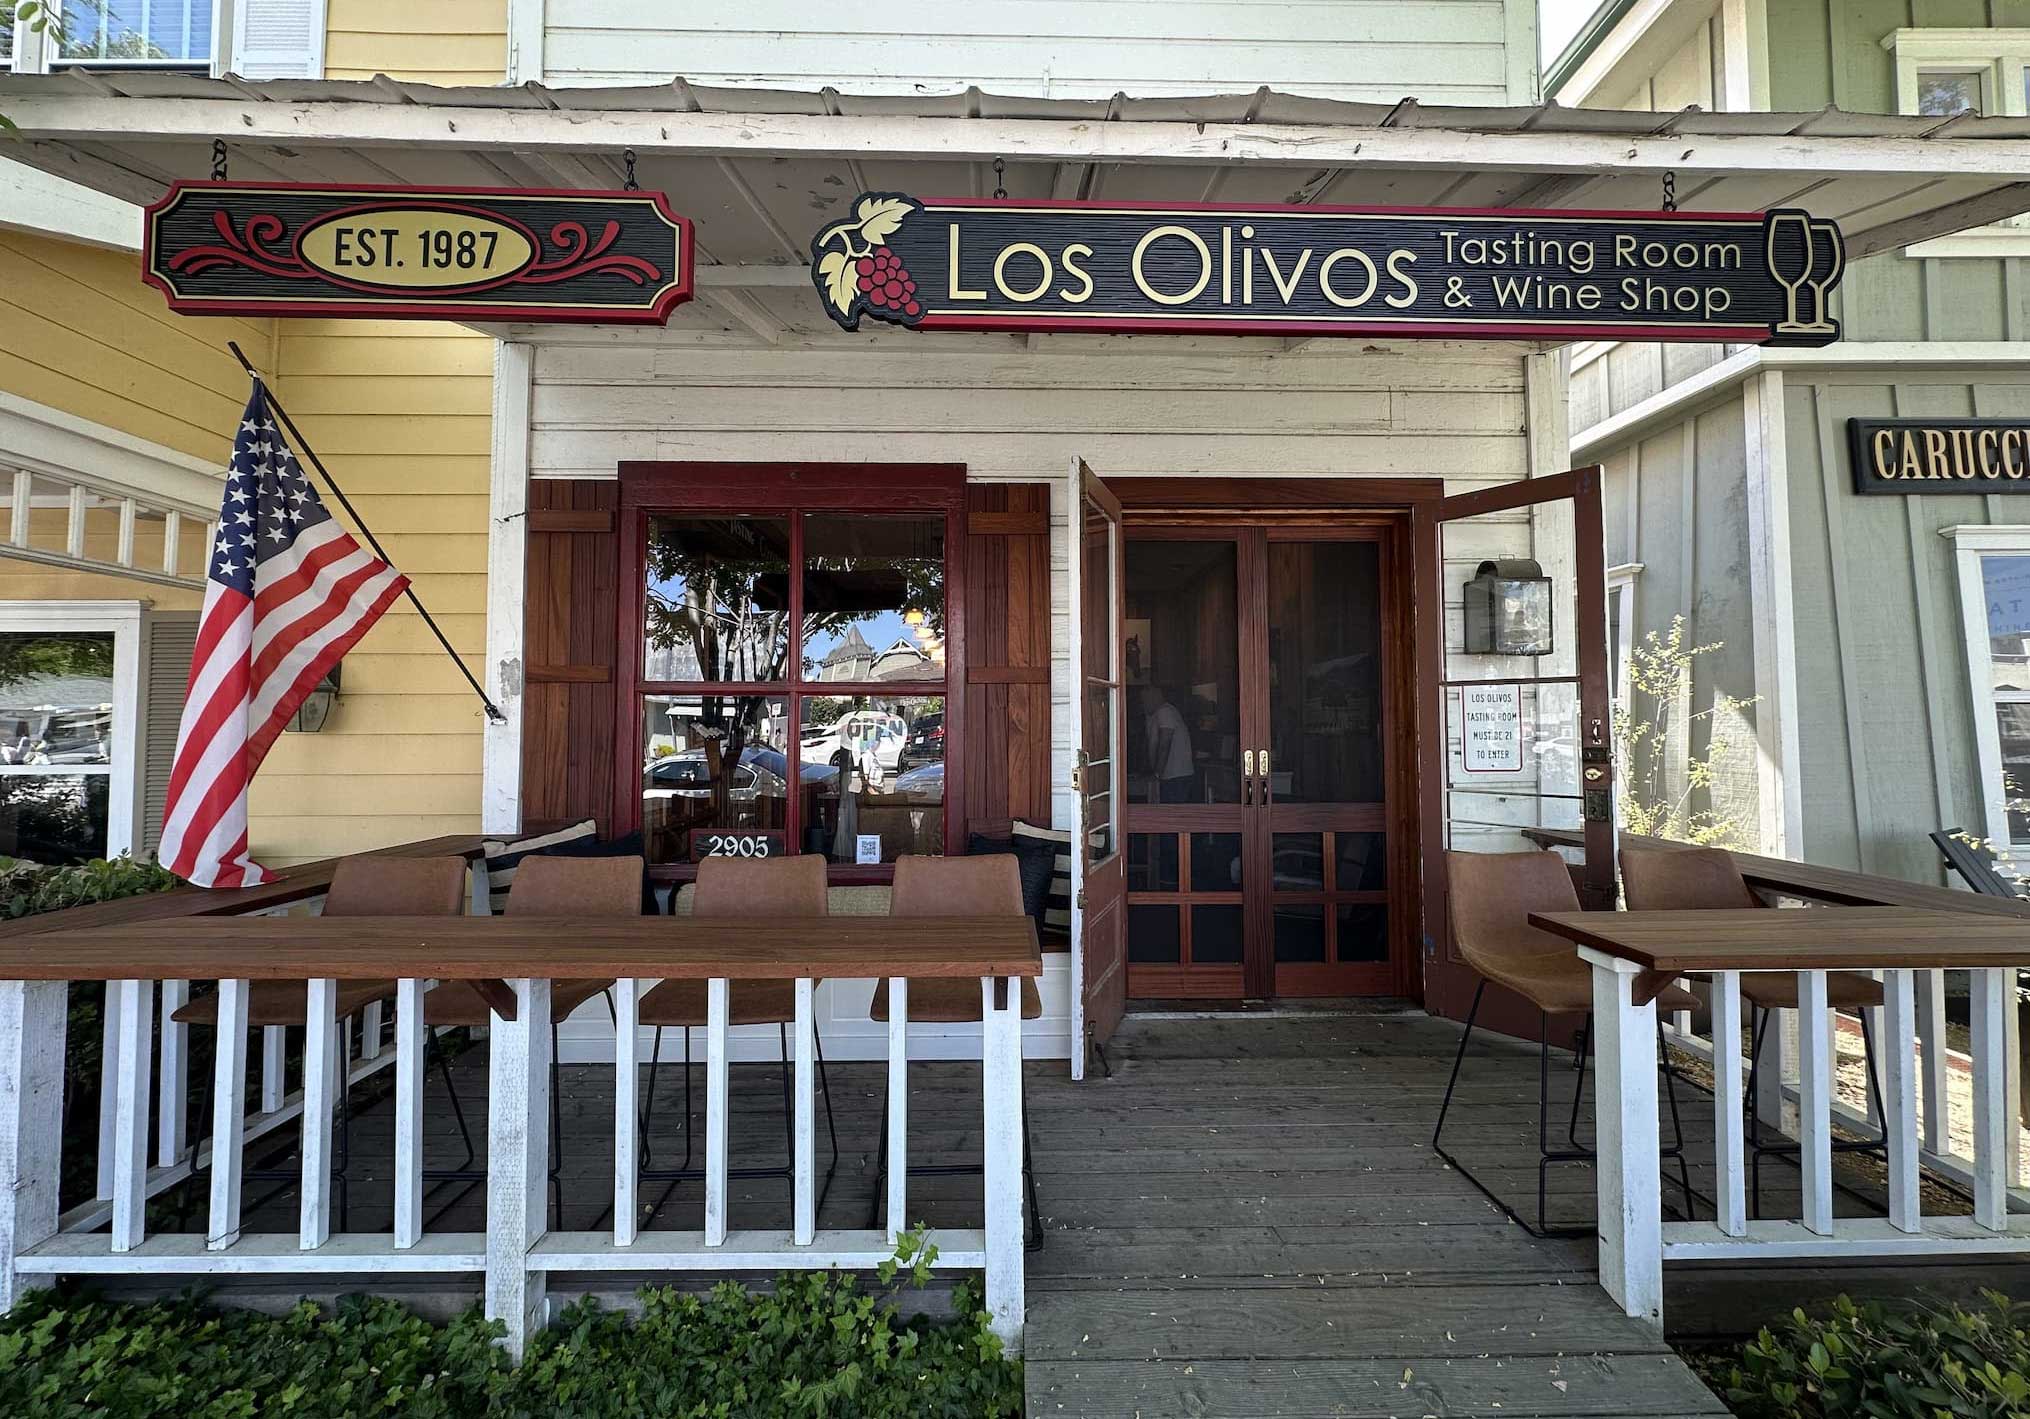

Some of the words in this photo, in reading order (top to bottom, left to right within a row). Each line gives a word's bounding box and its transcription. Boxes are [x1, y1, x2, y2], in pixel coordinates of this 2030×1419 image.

[335, 228, 404, 267] EST.
[418, 230, 498, 269] 1987
[1440, 231, 1594, 274] Tasting
[1615, 234, 1741, 268] Room
[948, 223, 1095, 303] Los
[1131, 225, 1419, 308] Olivos
[1443, 276, 1473, 308] &
[1492, 275, 1601, 310] Wine
[1620, 277, 1731, 319] Shop
[1471, 693, 1486, 703] LOS
[1487, 693, 1512, 703] OLIVOS
[1466, 712, 1496, 722] TASTING
[1473, 731, 1492, 741] MUST
[1505, 731, 1512, 741] 21
[1476, 750, 1486, 759] TO
[1488, 750, 1510, 759] ENTER
[708, 834, 769, 859] 2905
